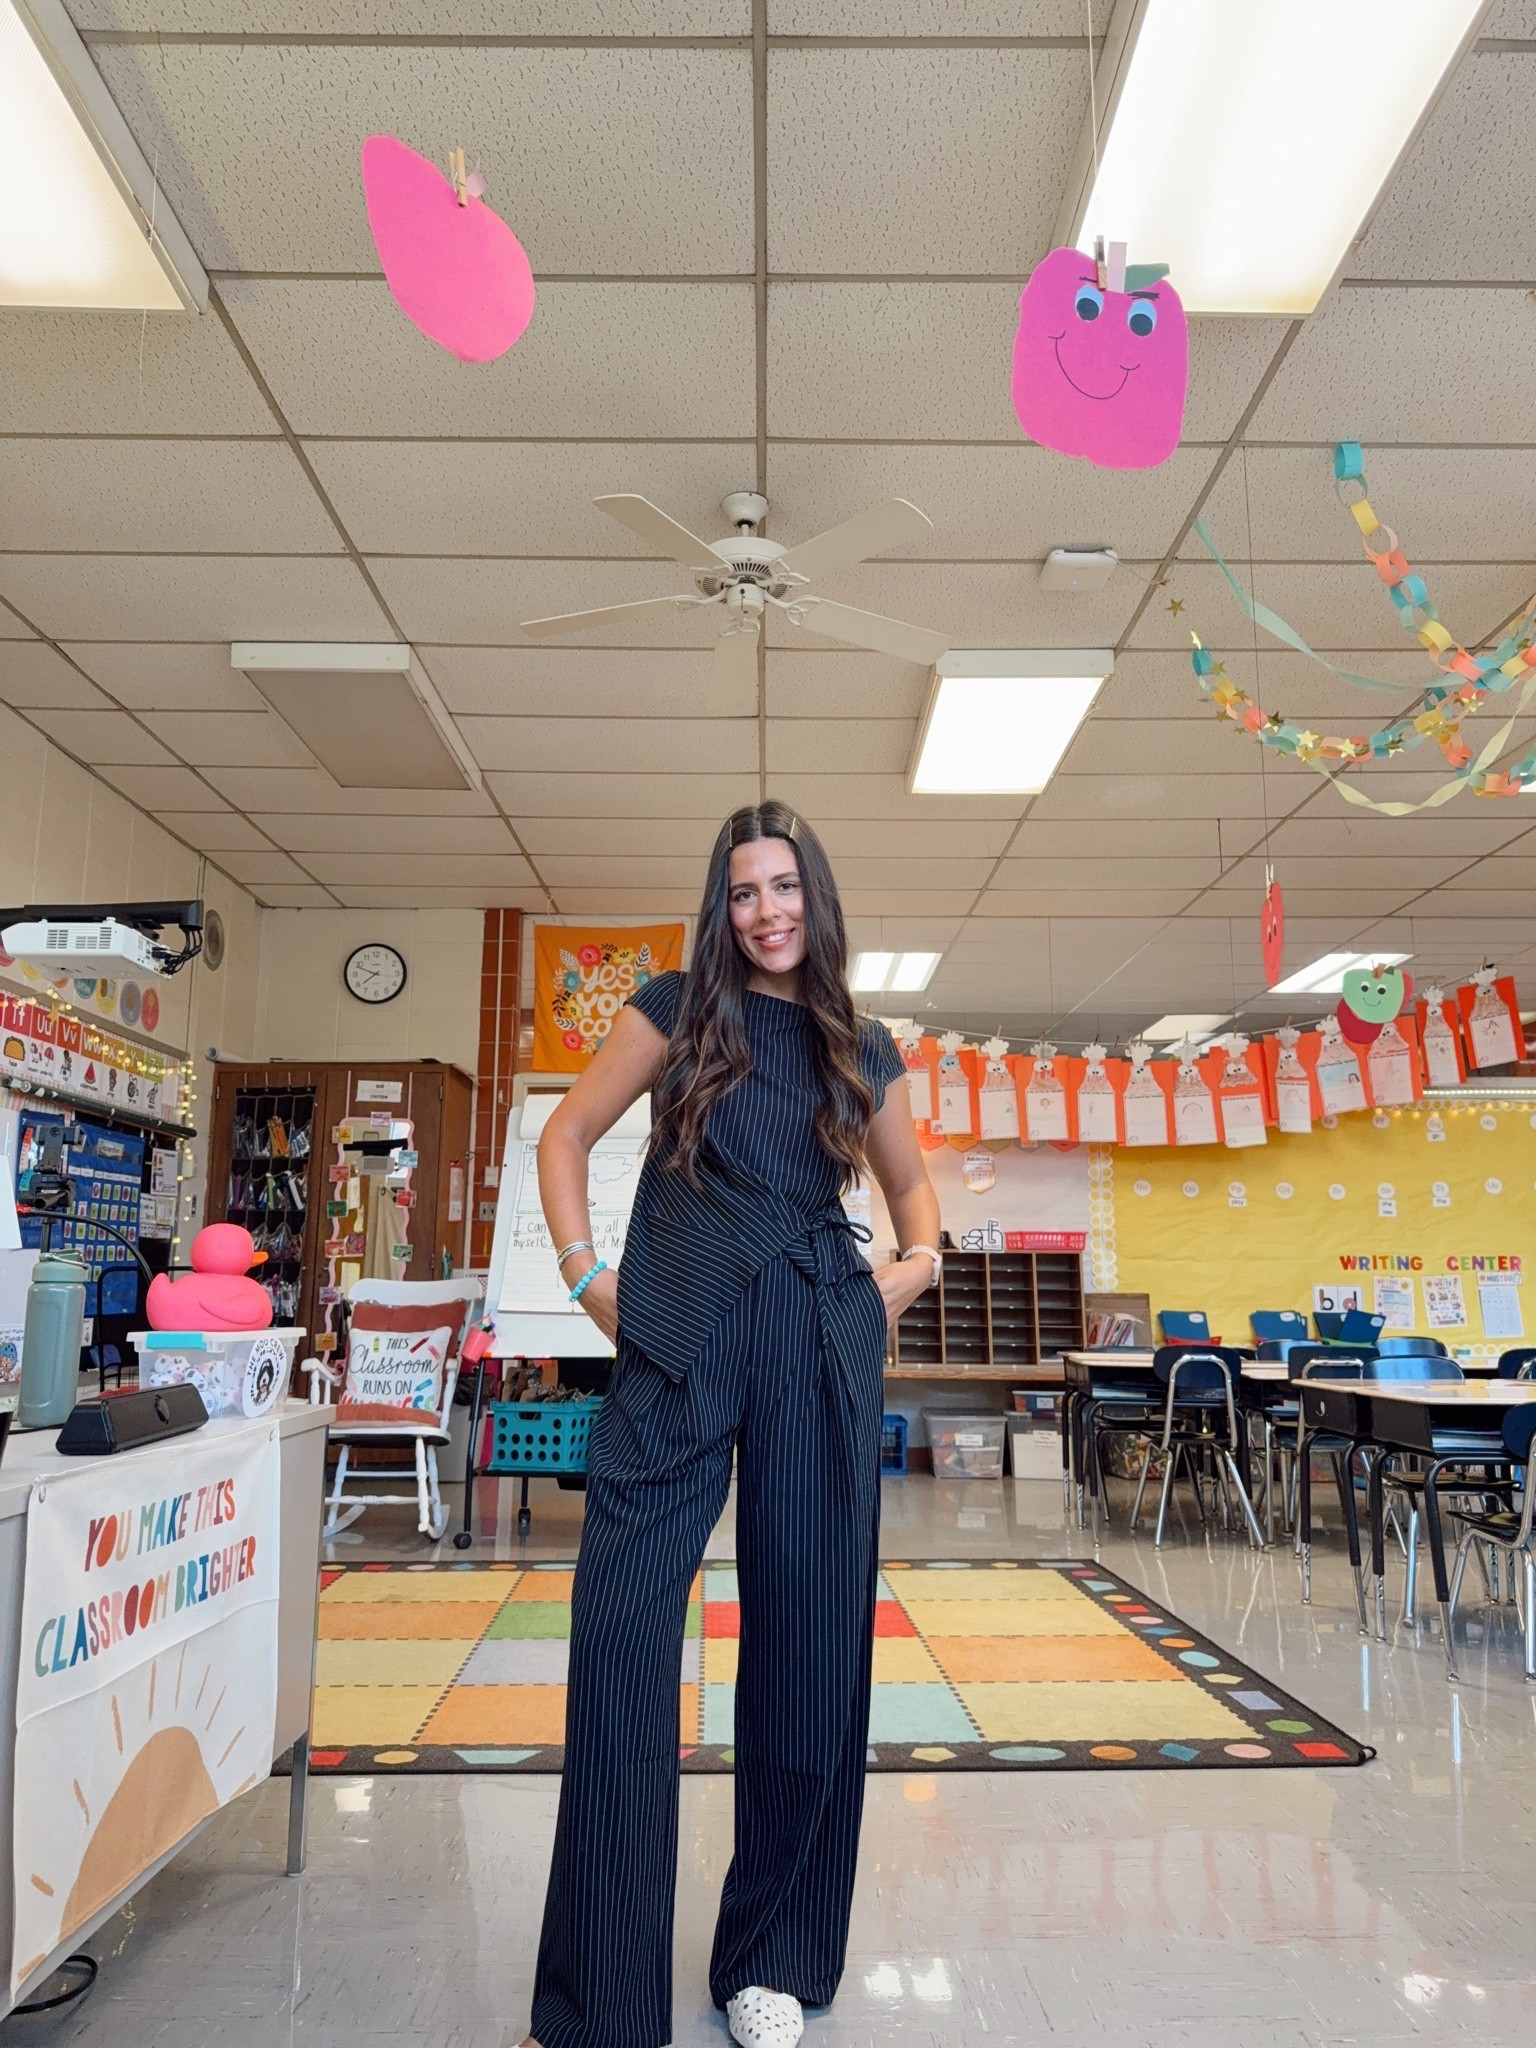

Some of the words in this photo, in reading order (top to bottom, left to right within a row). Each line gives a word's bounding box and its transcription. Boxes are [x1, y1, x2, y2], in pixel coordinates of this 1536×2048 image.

[580, 963, 634, 993] yes
[37, 1013, 52, 1036] Uu
[63, 1022, 77, 1045] Vv
[527, 1221, 547, 1233] can
[605, 1217, 618, 1233] all
[1339, 1255, 1423, 1271] WRITING
[1446, 1255, 1522, 1271] CENTER
[1319, 1289, 1334, 1311] b
[386, 1338, 410, 1350] THIS
[247, 1355, 256, 1376] THE
[270, 1338, 285, 1361] CREW
[349, 1344, 439, 1375] Classroom
[362, 1380, 392, 1395] RUNS
[395, 1380, 412, 1394] ON
[85, 1509, 133, 1573] YOU
[137, 1492, 192, 1556] MAKE
[194, 1478, 236, 1533] THIS
[34, 1570, 171, 1678] CLASSROOM
[174, 1535, 257, 1614] BRIGHTER
